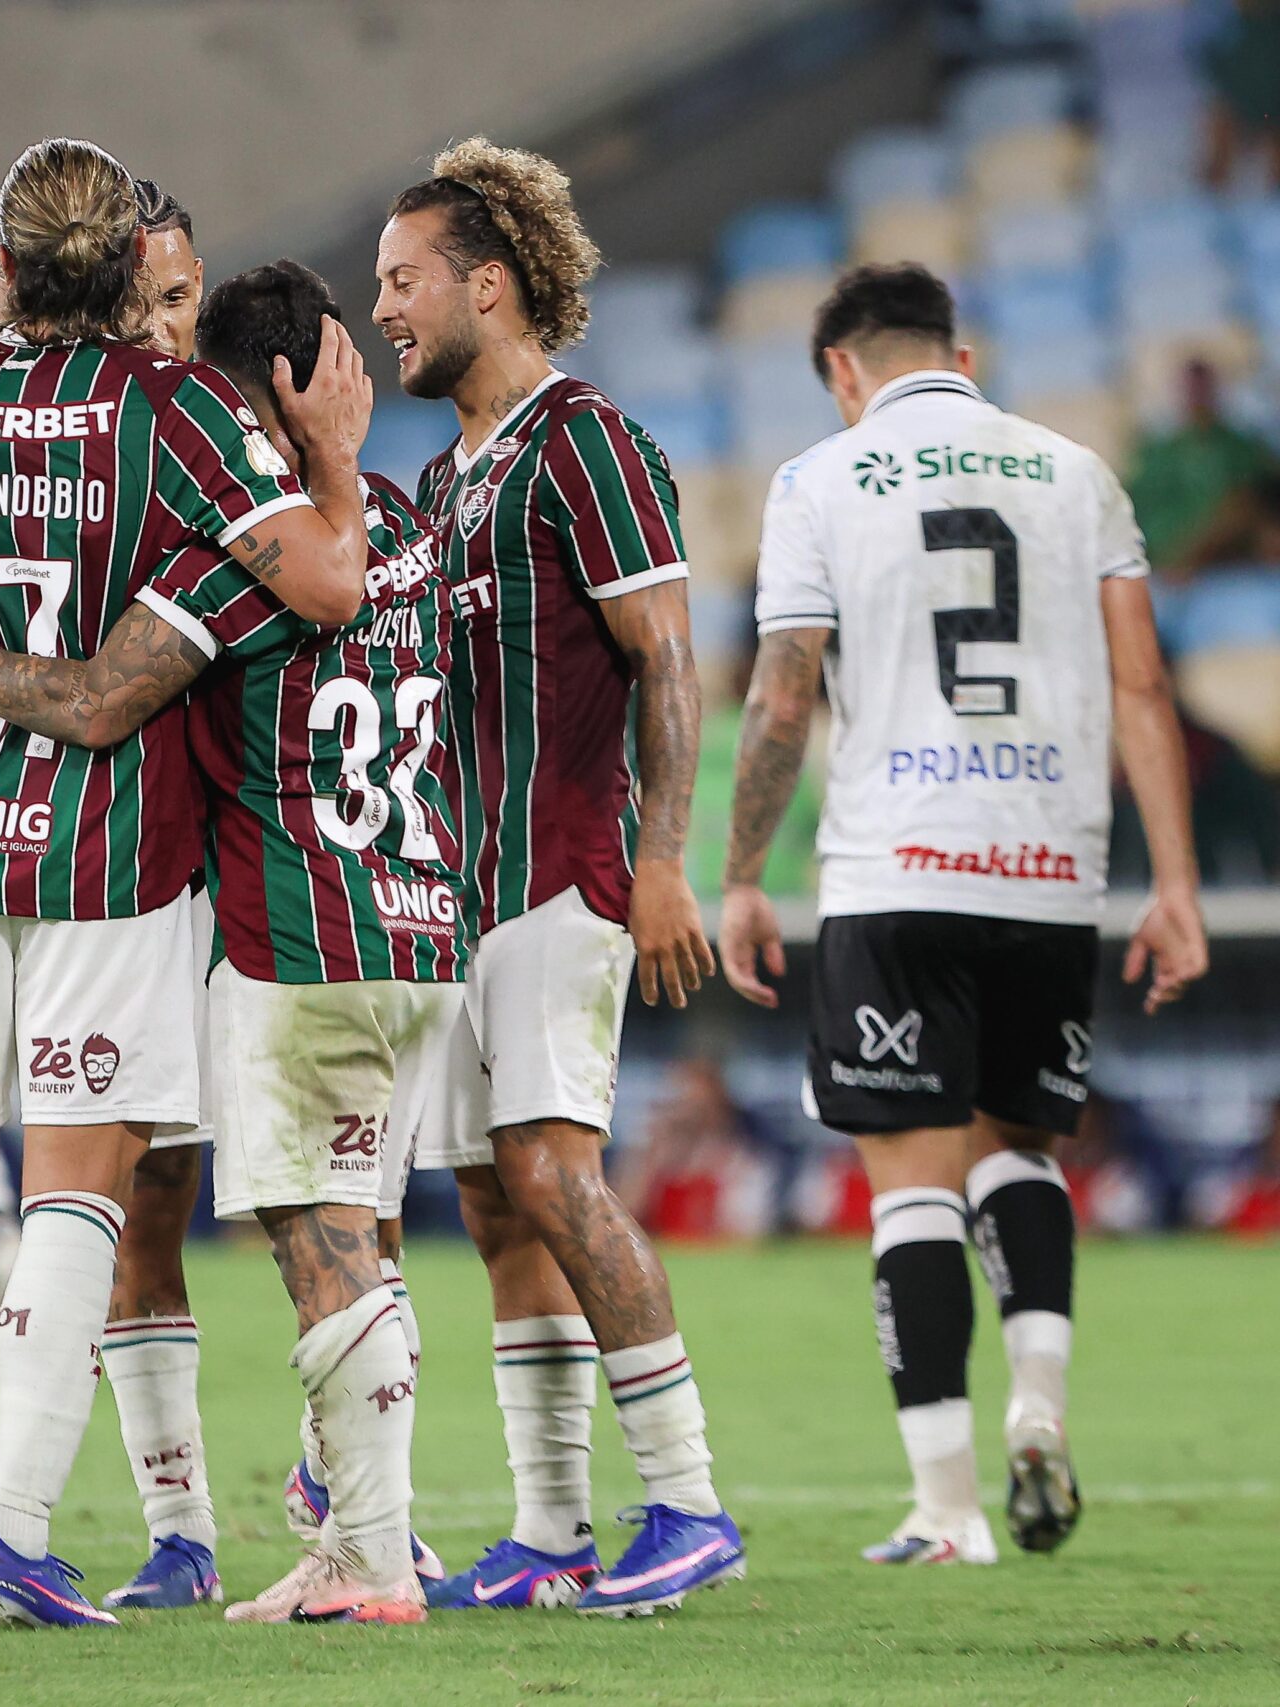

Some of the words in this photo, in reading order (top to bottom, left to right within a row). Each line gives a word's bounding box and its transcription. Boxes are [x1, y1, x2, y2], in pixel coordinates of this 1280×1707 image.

[915, 446, 1055, 484] Sicredi
[13, 567, 51, 579] predialnet
[920, 508, 1018, 717] 2
[307, 675, 443, 862] 32
[9, 842, 48, 855] IGUAÇU
[894, 843, 1079, 882] makita
[371, 878, 456, 924] UNIG
[29, 1037, 76, 1079] Zé
[28, 1082, 76, 1095] DELIVERY
[329, 1113, 378, 1157] Zé
